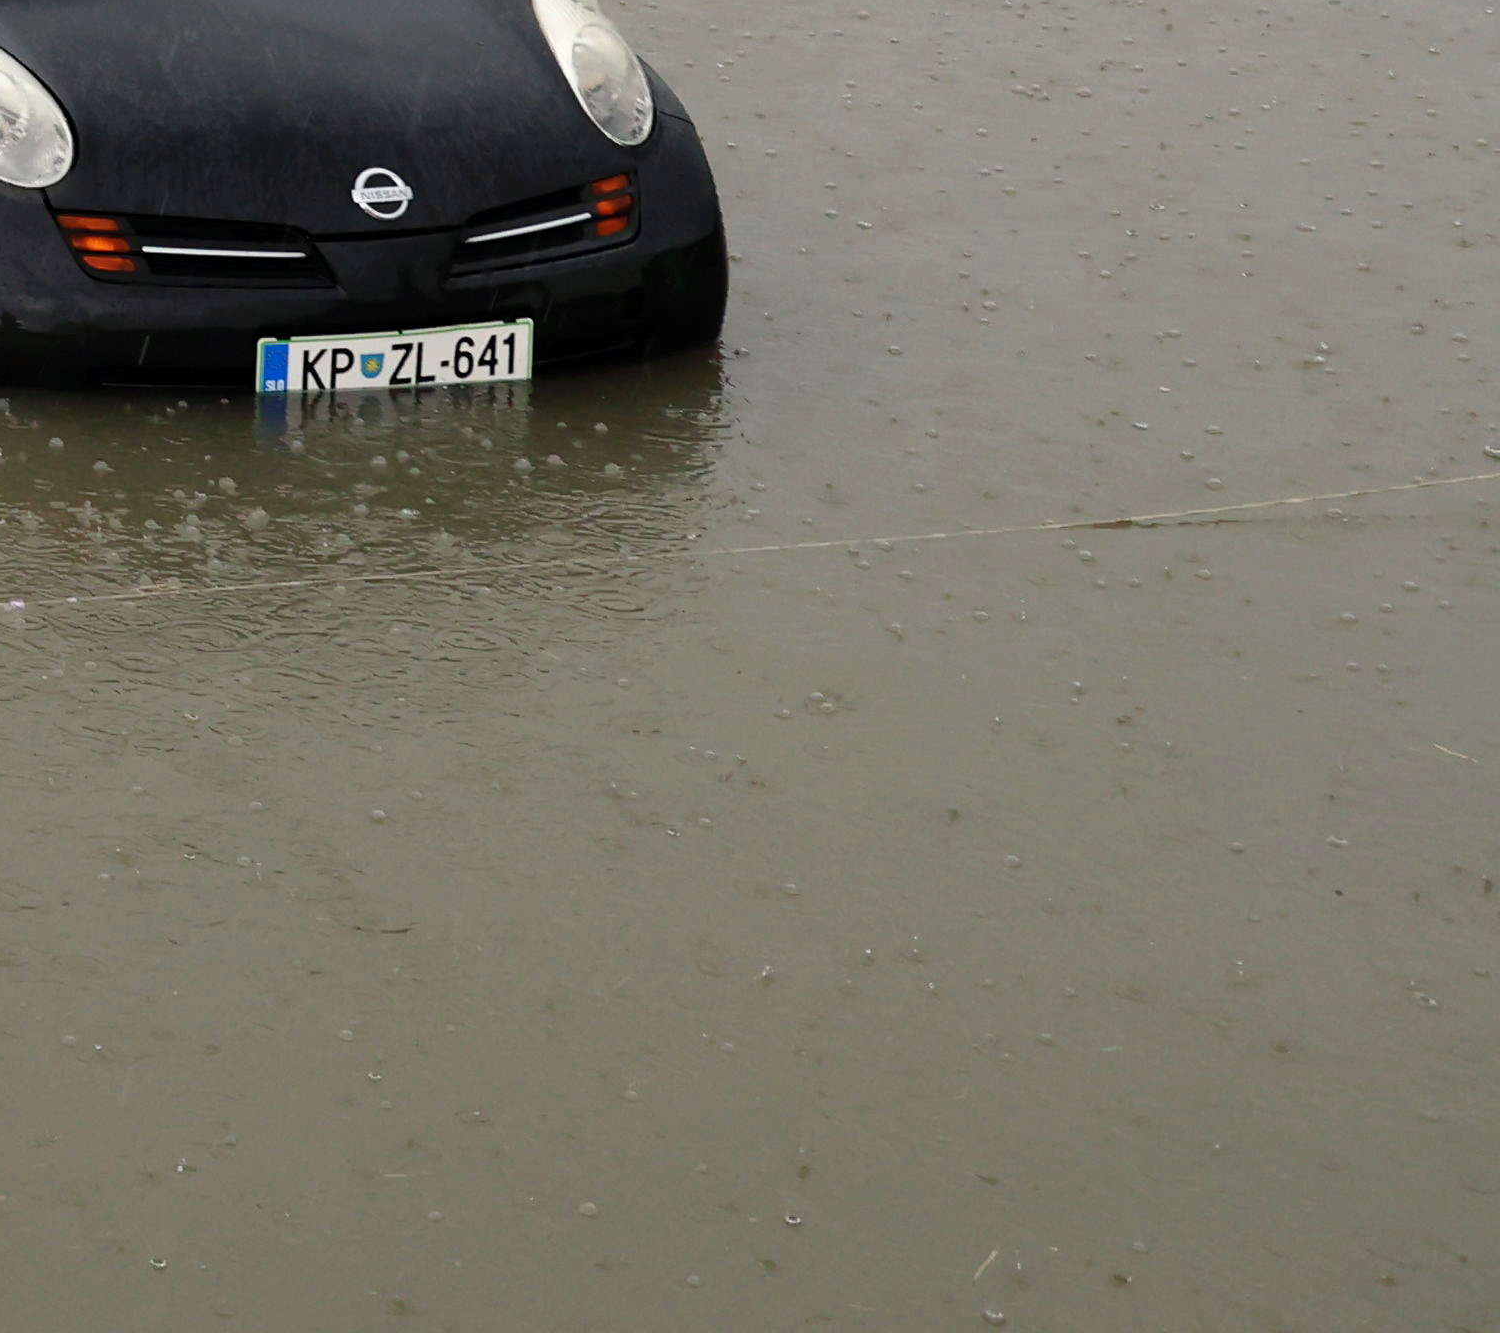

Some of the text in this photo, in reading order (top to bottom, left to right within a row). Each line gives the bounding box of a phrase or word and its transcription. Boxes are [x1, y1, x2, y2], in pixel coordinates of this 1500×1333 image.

[360, 189, 408, 200] NISSAN
[302, 348, 355, 391] KP
[389, 332, 516, 386] ZL-641
